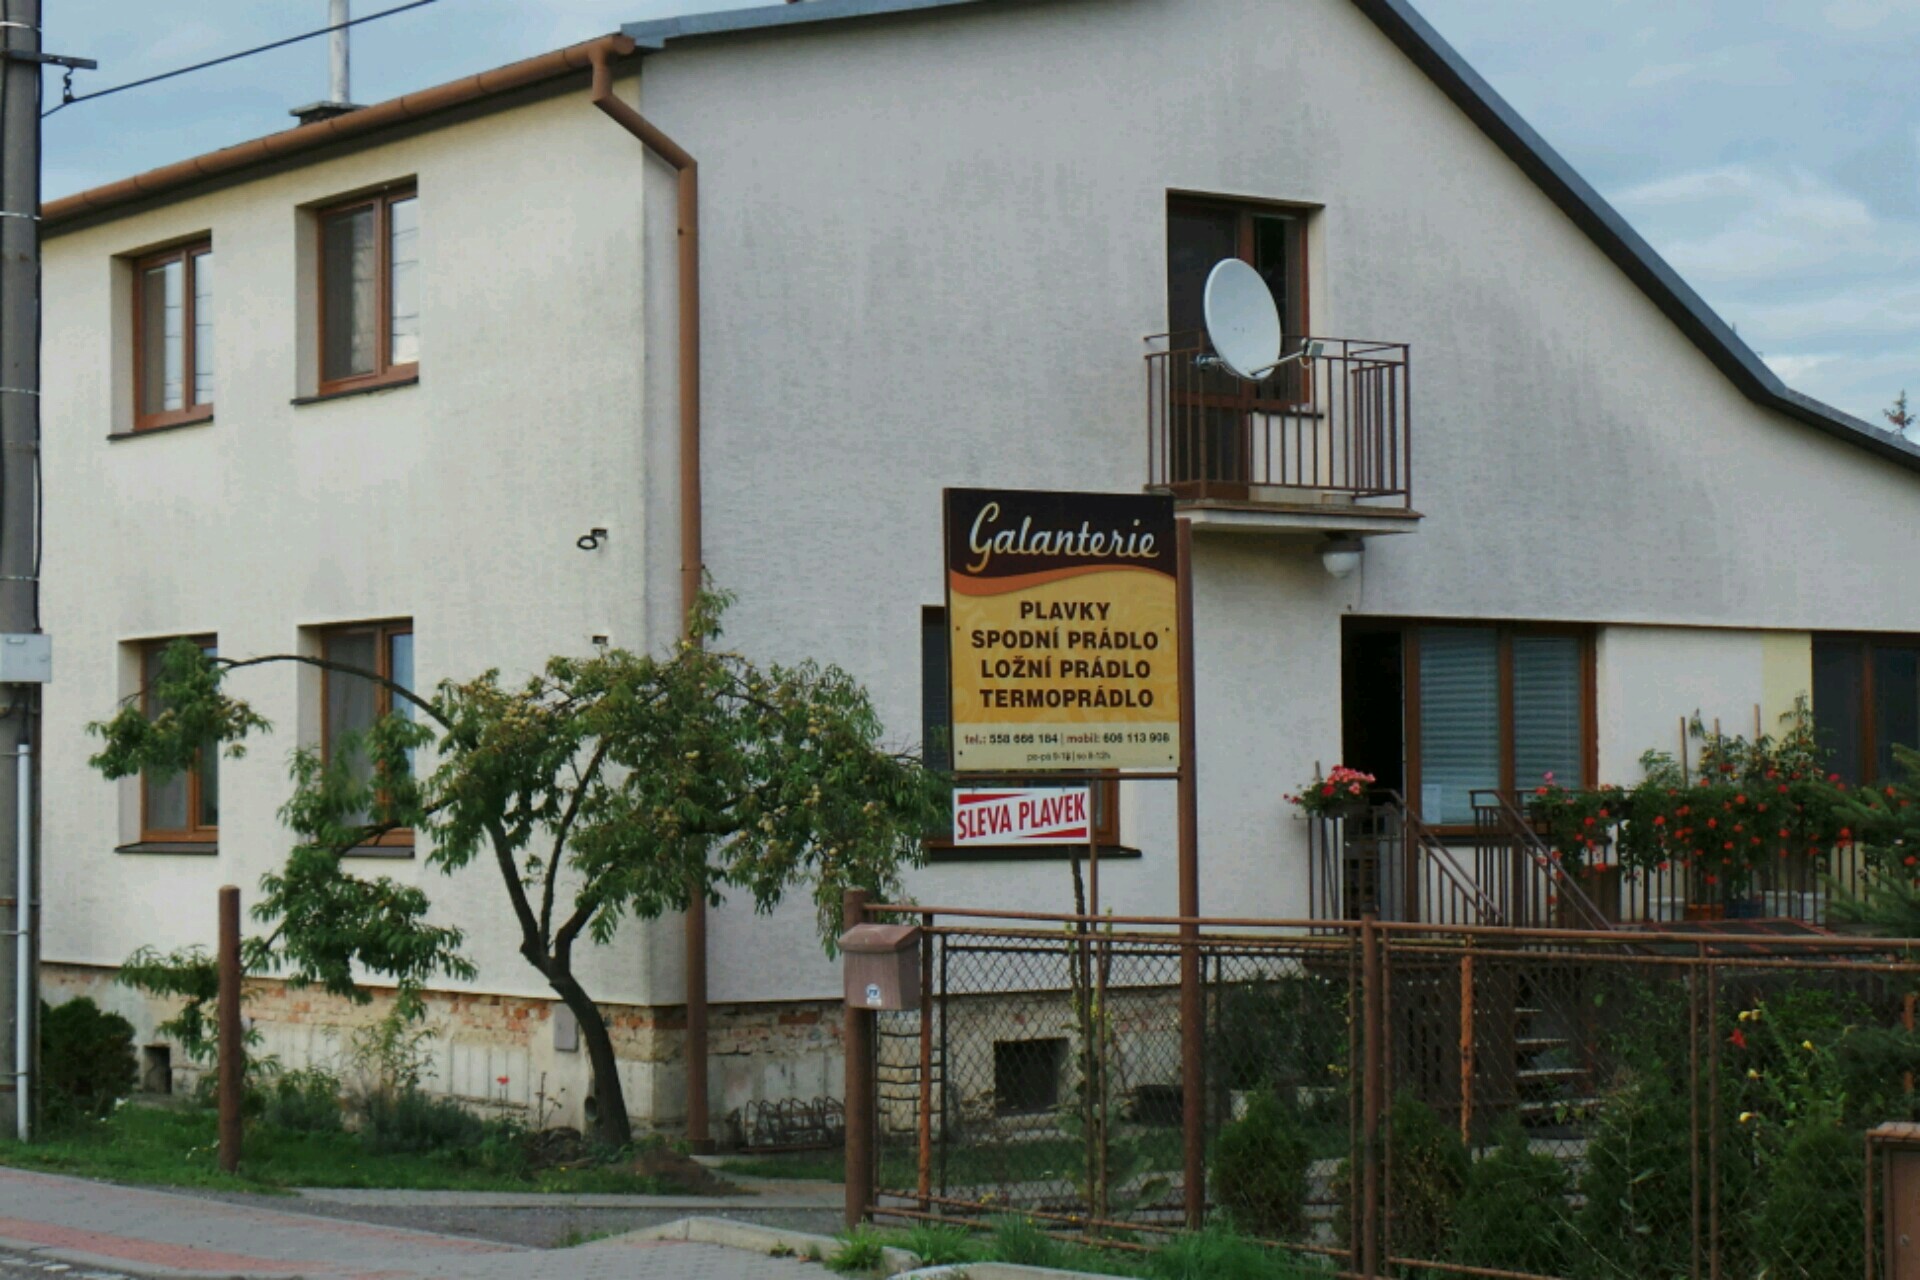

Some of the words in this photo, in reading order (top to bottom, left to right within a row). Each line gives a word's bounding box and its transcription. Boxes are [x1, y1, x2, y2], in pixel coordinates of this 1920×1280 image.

[966, 501, 1160, 573] Galanterie
[1020, 601, 1111, 621] PLAVKY
[971, 626, 1059, 649] SPODNÍ
[1067, 628, 1159, 651] PRÁDLO
[981, 656, 1052, 679] LOŽNÍ
[1060, 656, 1151, 679] PRÁDLO
[979, 685, 1154, 708] TERMOPRÁDLO
[965, 733, 987, 745] tel.:
[1066, 732, 1101, 744] mobil:
[1127, 732, 1146, 743] 113
[957, 804, 1012, 840] SLEVA
[1018, 792, 1086, 830] PLAVEK
